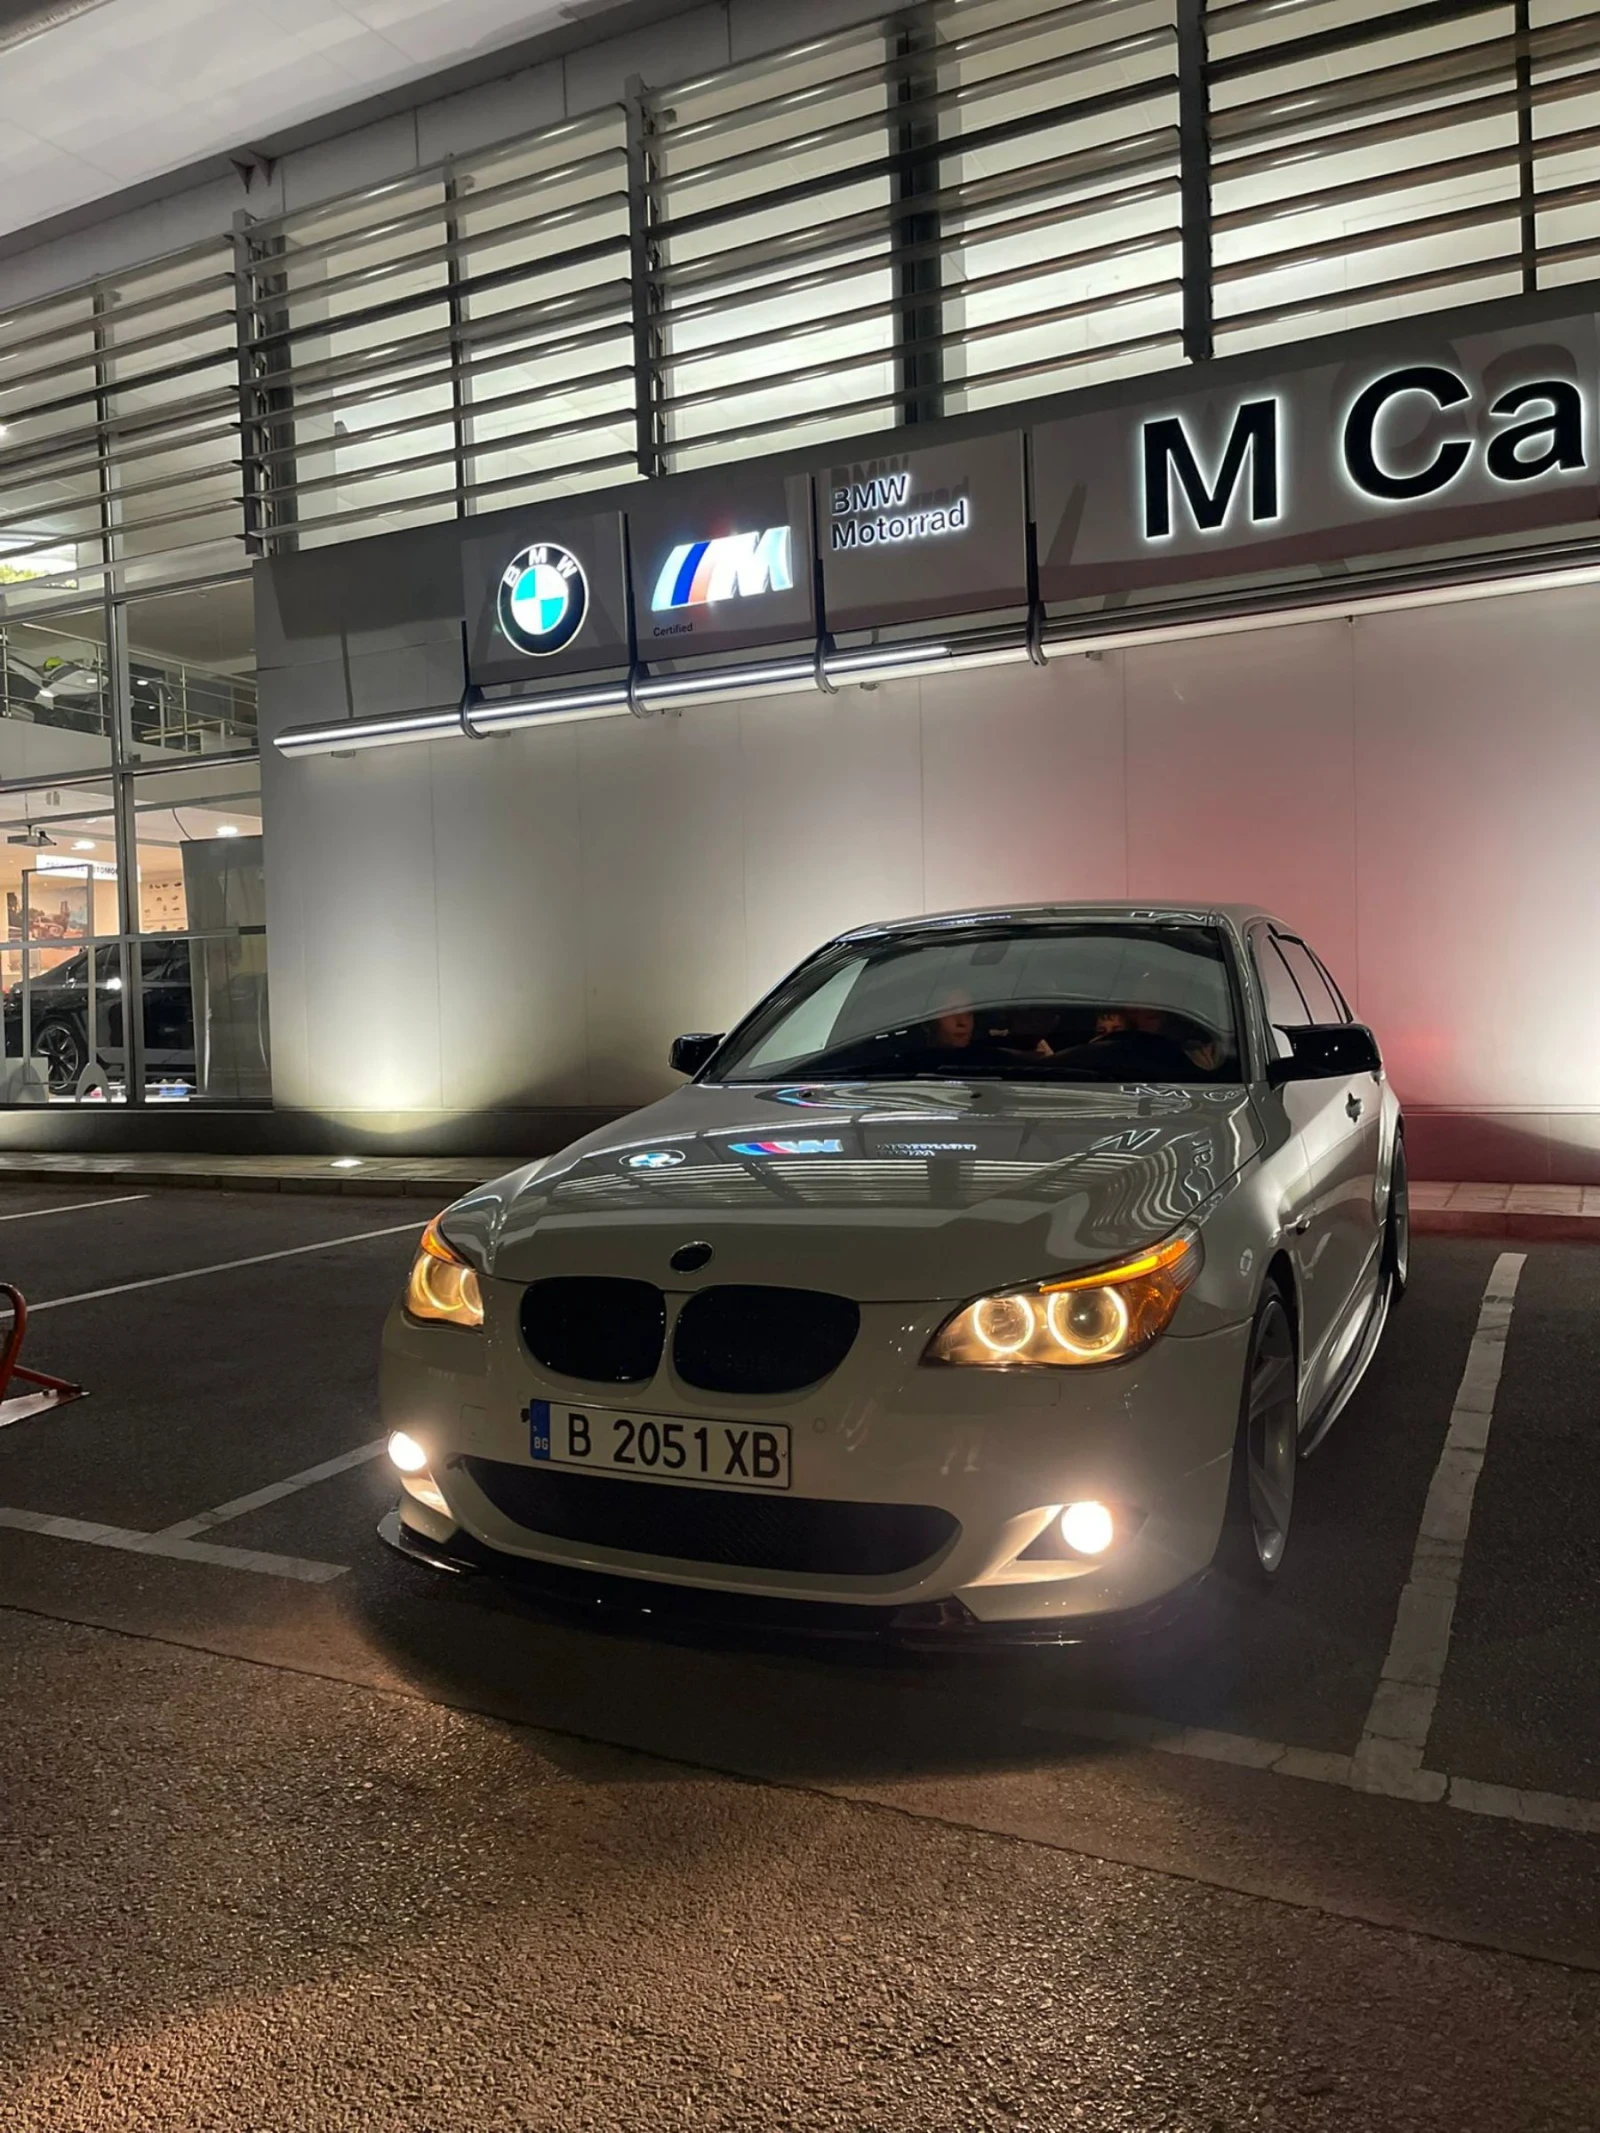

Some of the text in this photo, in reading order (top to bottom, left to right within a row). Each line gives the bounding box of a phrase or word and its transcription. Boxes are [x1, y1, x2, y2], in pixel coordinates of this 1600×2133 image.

[1143, 366, 1588, 539] M Ca
[832, 474, 908, 515] BMW
[831, 499, 966, 549] Motorrad
[503, 546, 578, 588] BMW
[703, 525, 793, 603] M
[653, 623, 693, 637] Certified
[534, 1436, 549, 1451] BG
[568, 1412, 780, 1479] B 2051 XB
